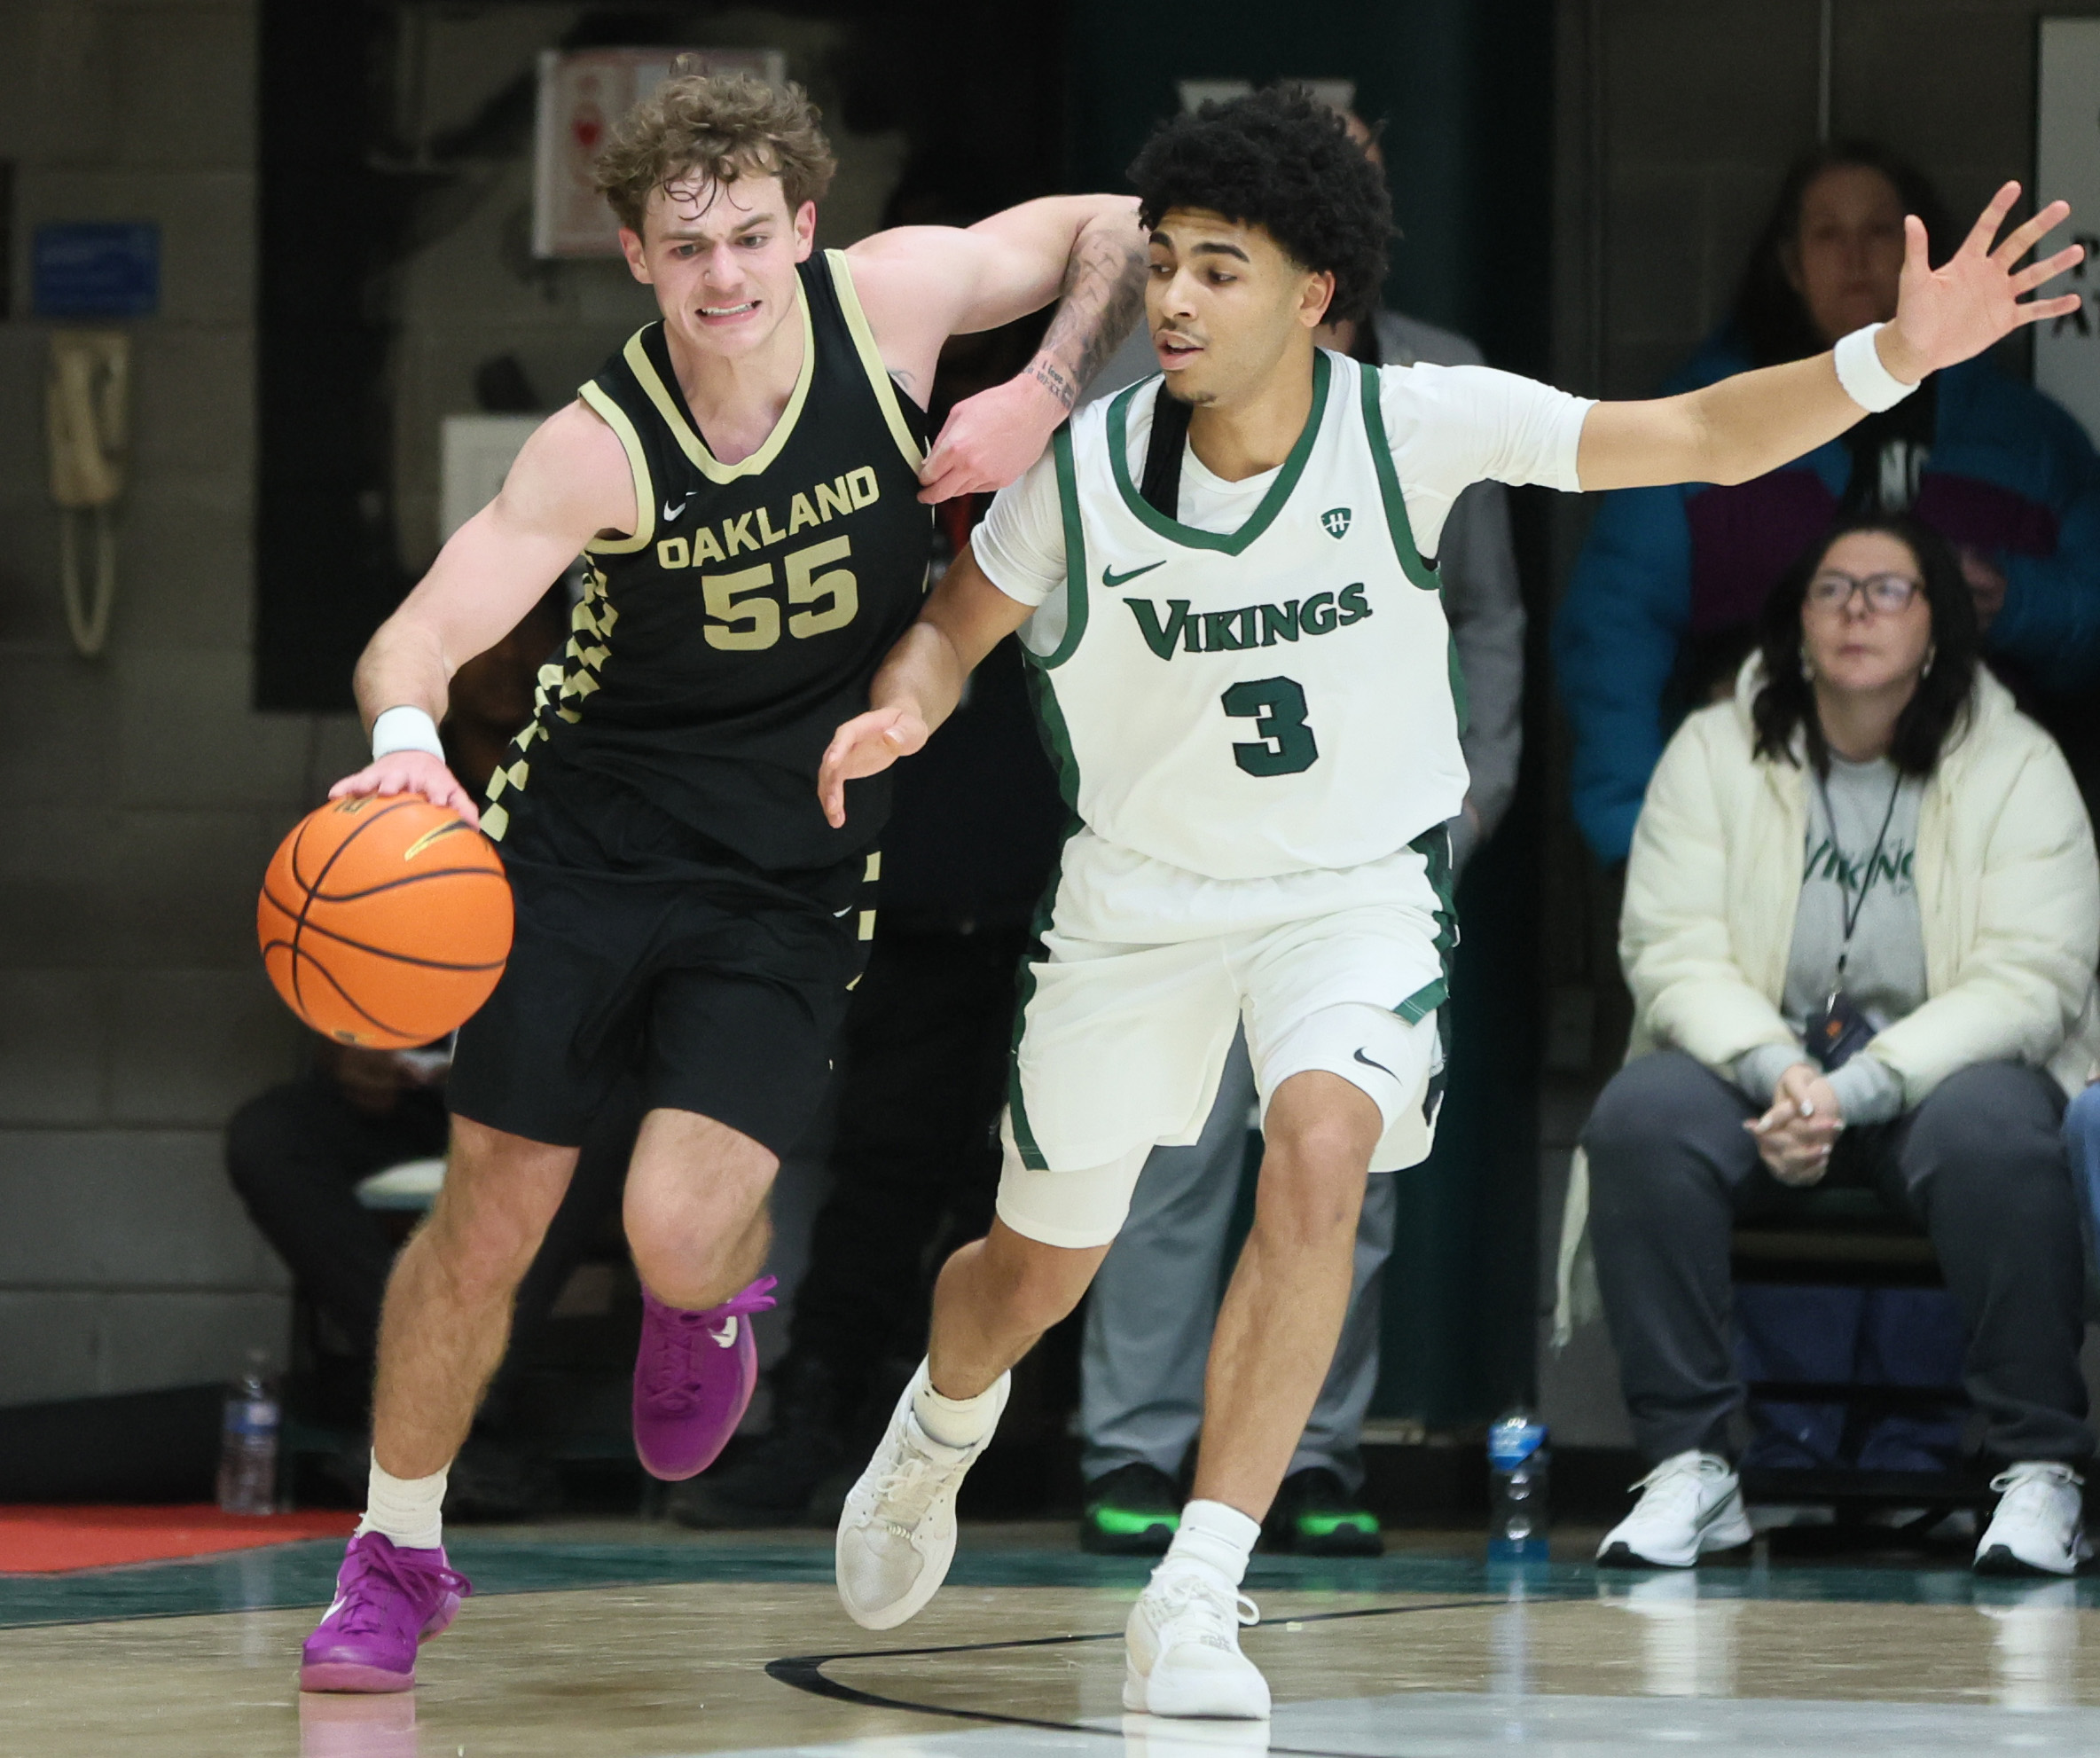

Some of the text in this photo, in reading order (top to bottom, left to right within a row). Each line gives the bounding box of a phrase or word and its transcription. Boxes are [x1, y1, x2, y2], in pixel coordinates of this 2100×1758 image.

[657, 466, 880, 569] OAKLAND
[701, 535, 858, 651] 55
[1123, 582, 1373, 661] VIKINGS
[1220, 676, 1319, 777] 3
